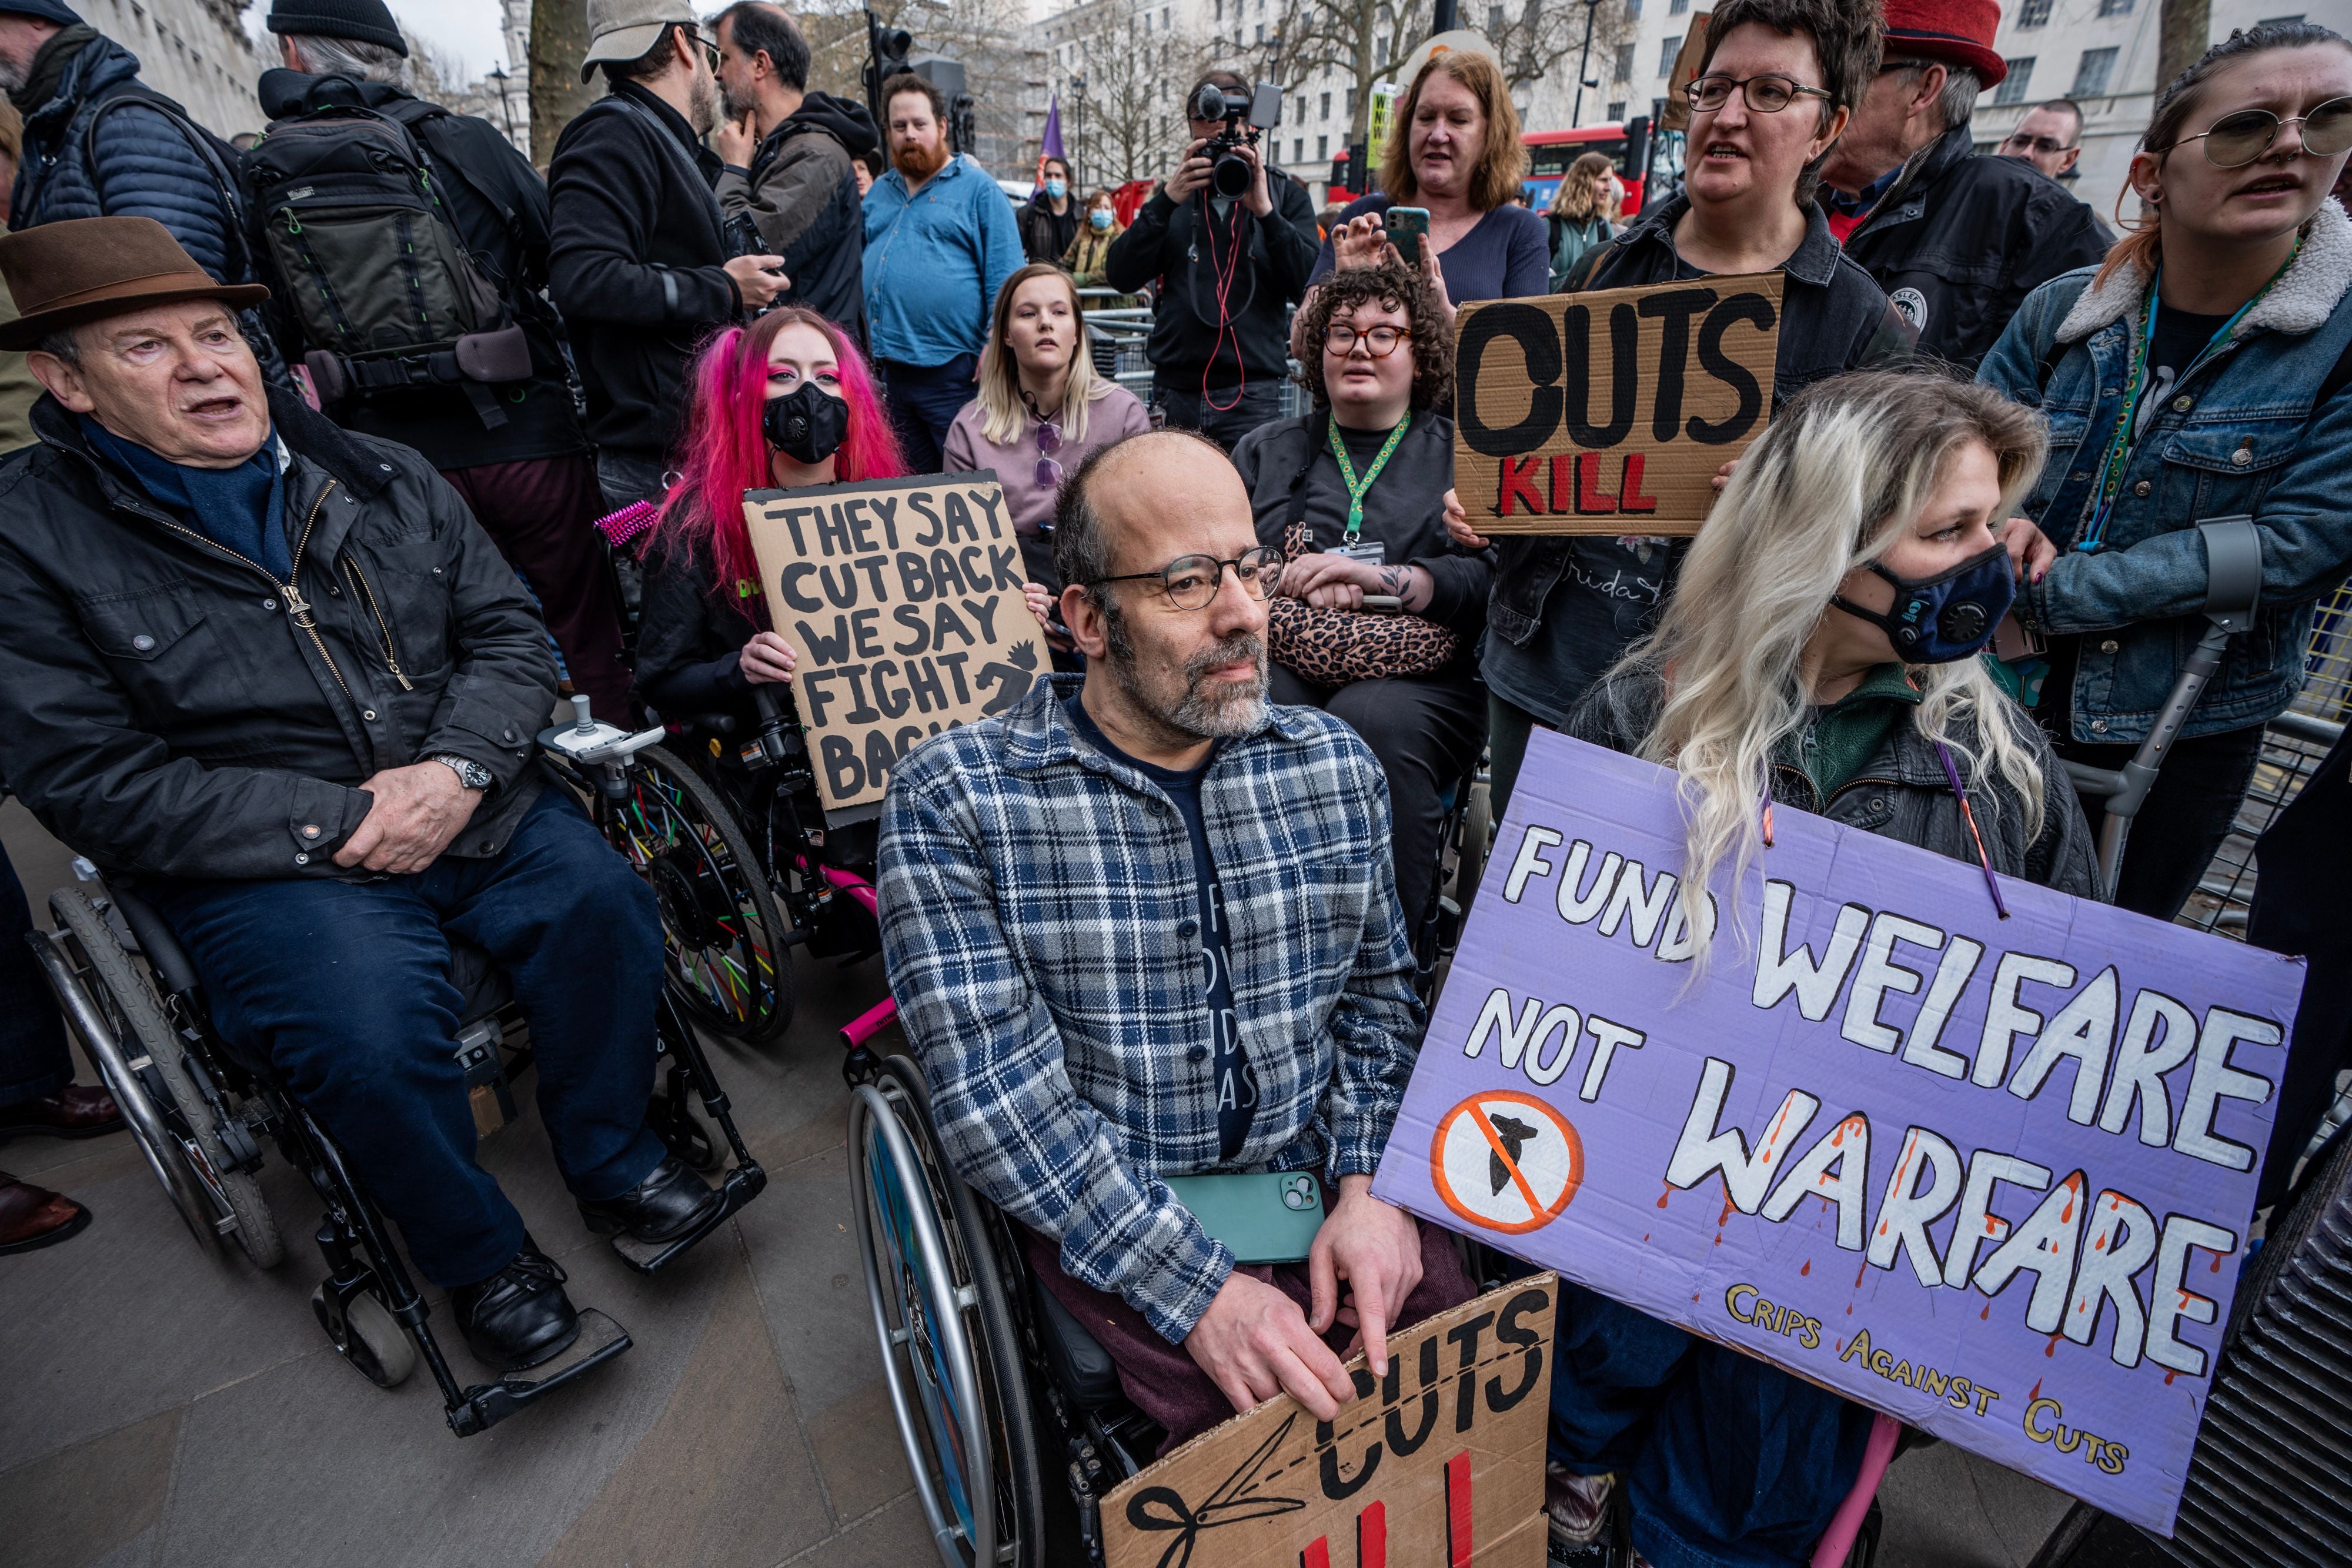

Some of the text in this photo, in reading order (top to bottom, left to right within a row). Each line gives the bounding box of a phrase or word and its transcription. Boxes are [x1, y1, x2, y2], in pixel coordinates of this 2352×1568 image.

[1456, 288, 1776, 457] CUTS
[764, 489, 1002, 557] THEY SAY
[1487, 452, 1658, 518] KILL
[781, 544, 1025, 613] CUT BACK
[794, 595, 1000, 667] WE SAY
[802, 651, 969, 728] FIGHT
[1502, 824, 2286, 1173] FUND WELFARE
[1463, 987, 2238, 1376] NOT WARFARE
[1315, 1289, 1549, 1500] CUTS
